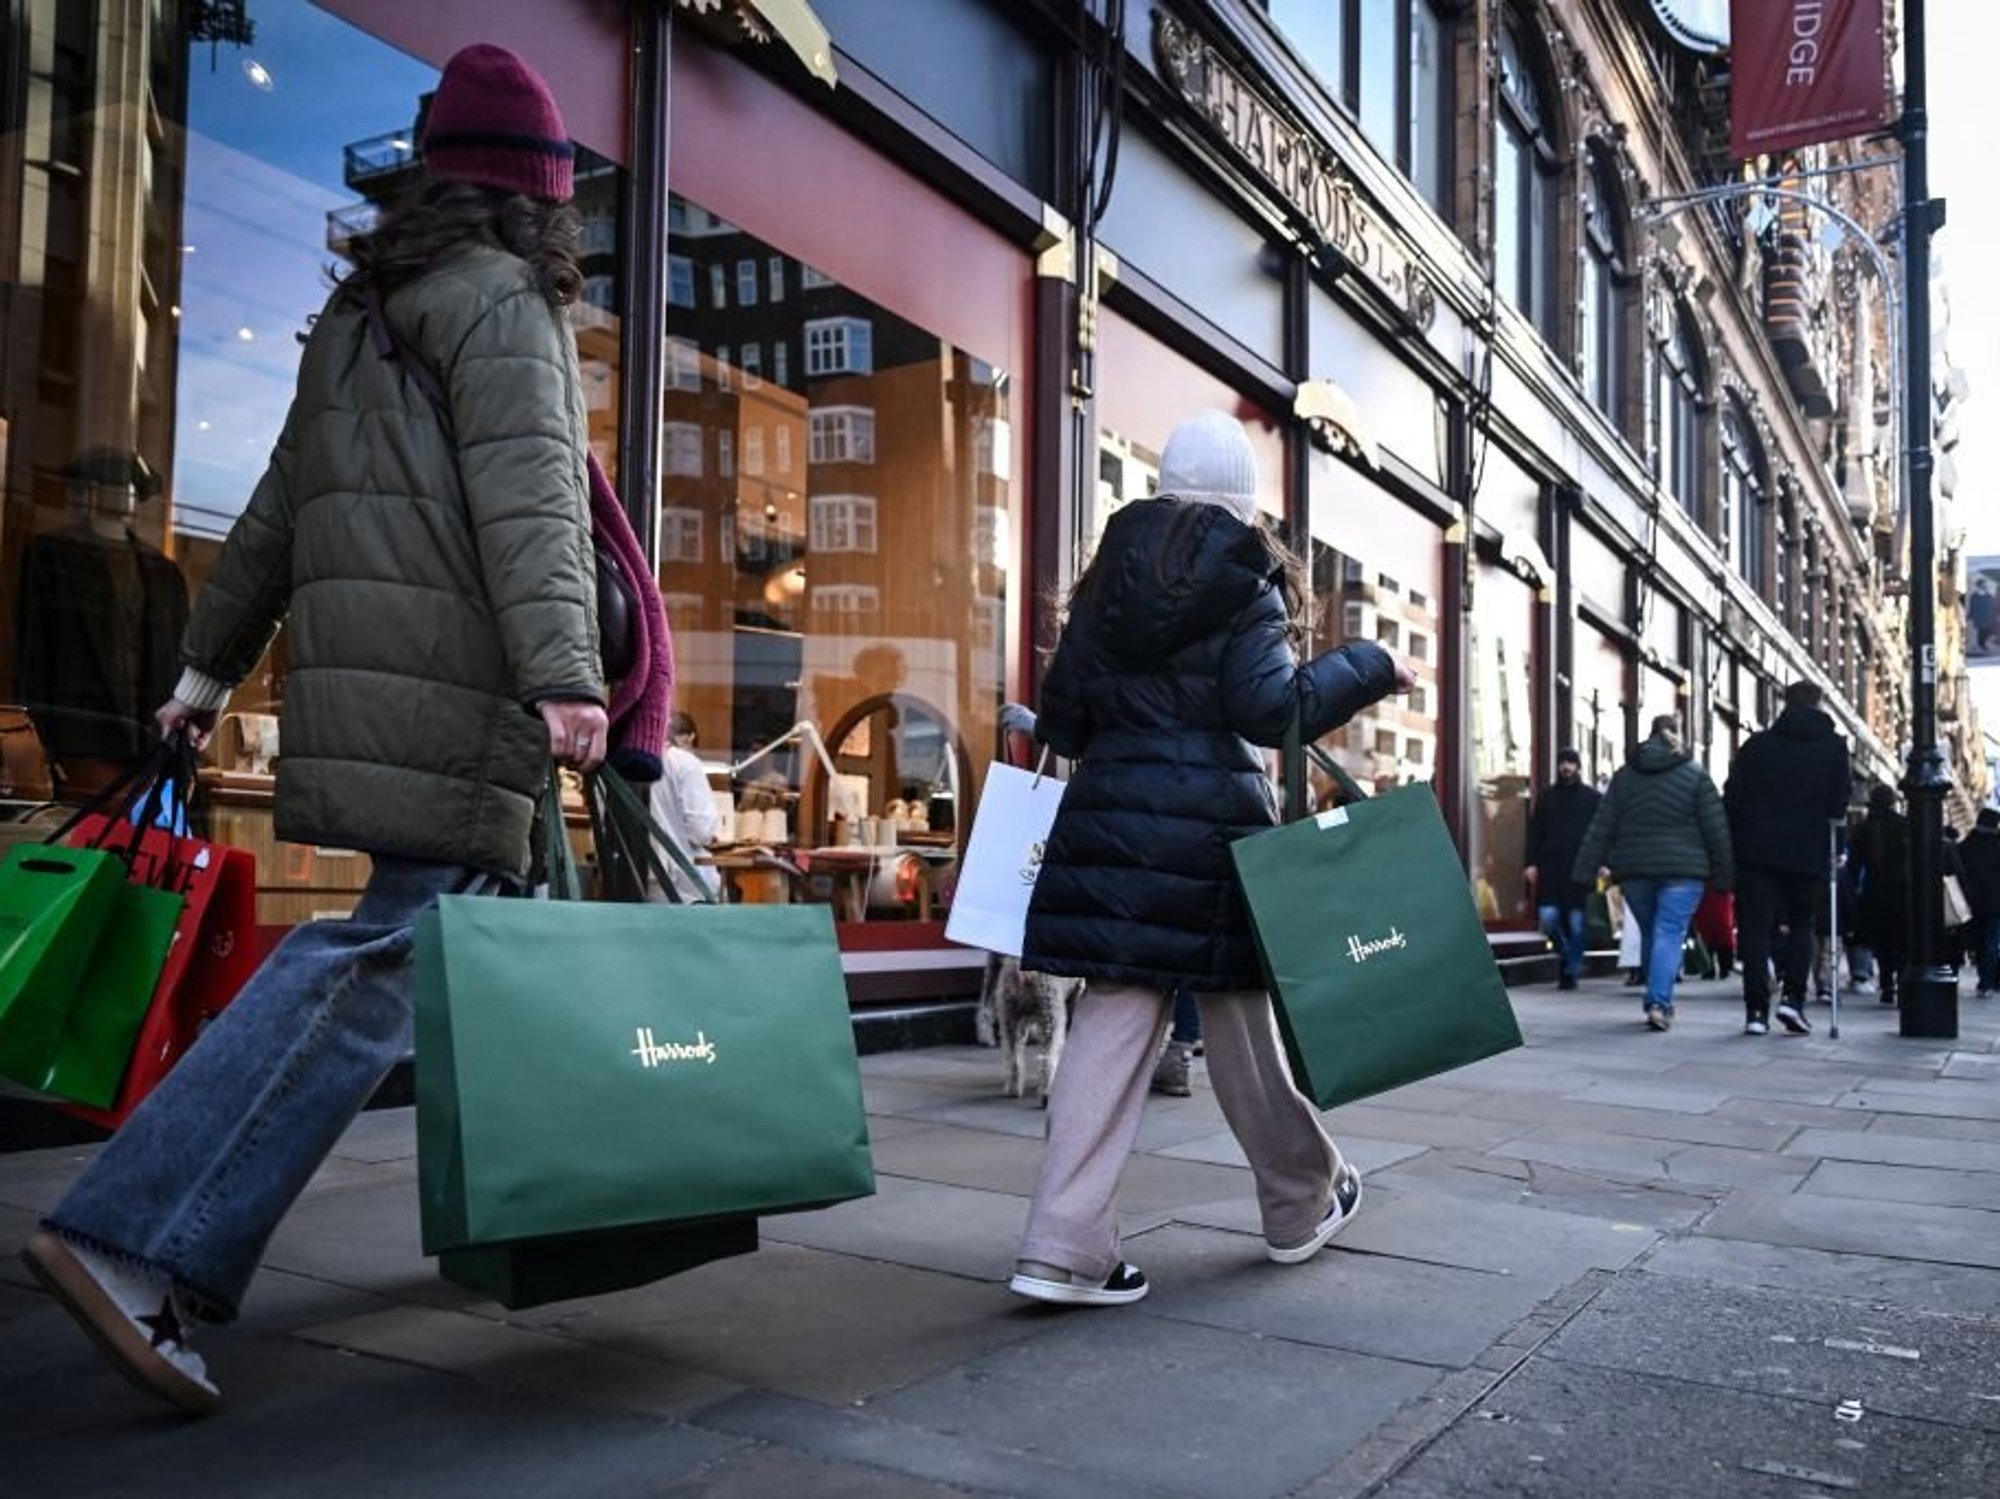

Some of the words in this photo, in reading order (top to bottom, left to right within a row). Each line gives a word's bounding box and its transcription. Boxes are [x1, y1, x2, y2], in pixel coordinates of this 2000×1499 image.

[1215, 64, 1370, 268] HARRODS
[1345, 926, 1407, 963] Harrods
[631, 1027, 717, 1067] Harrods
